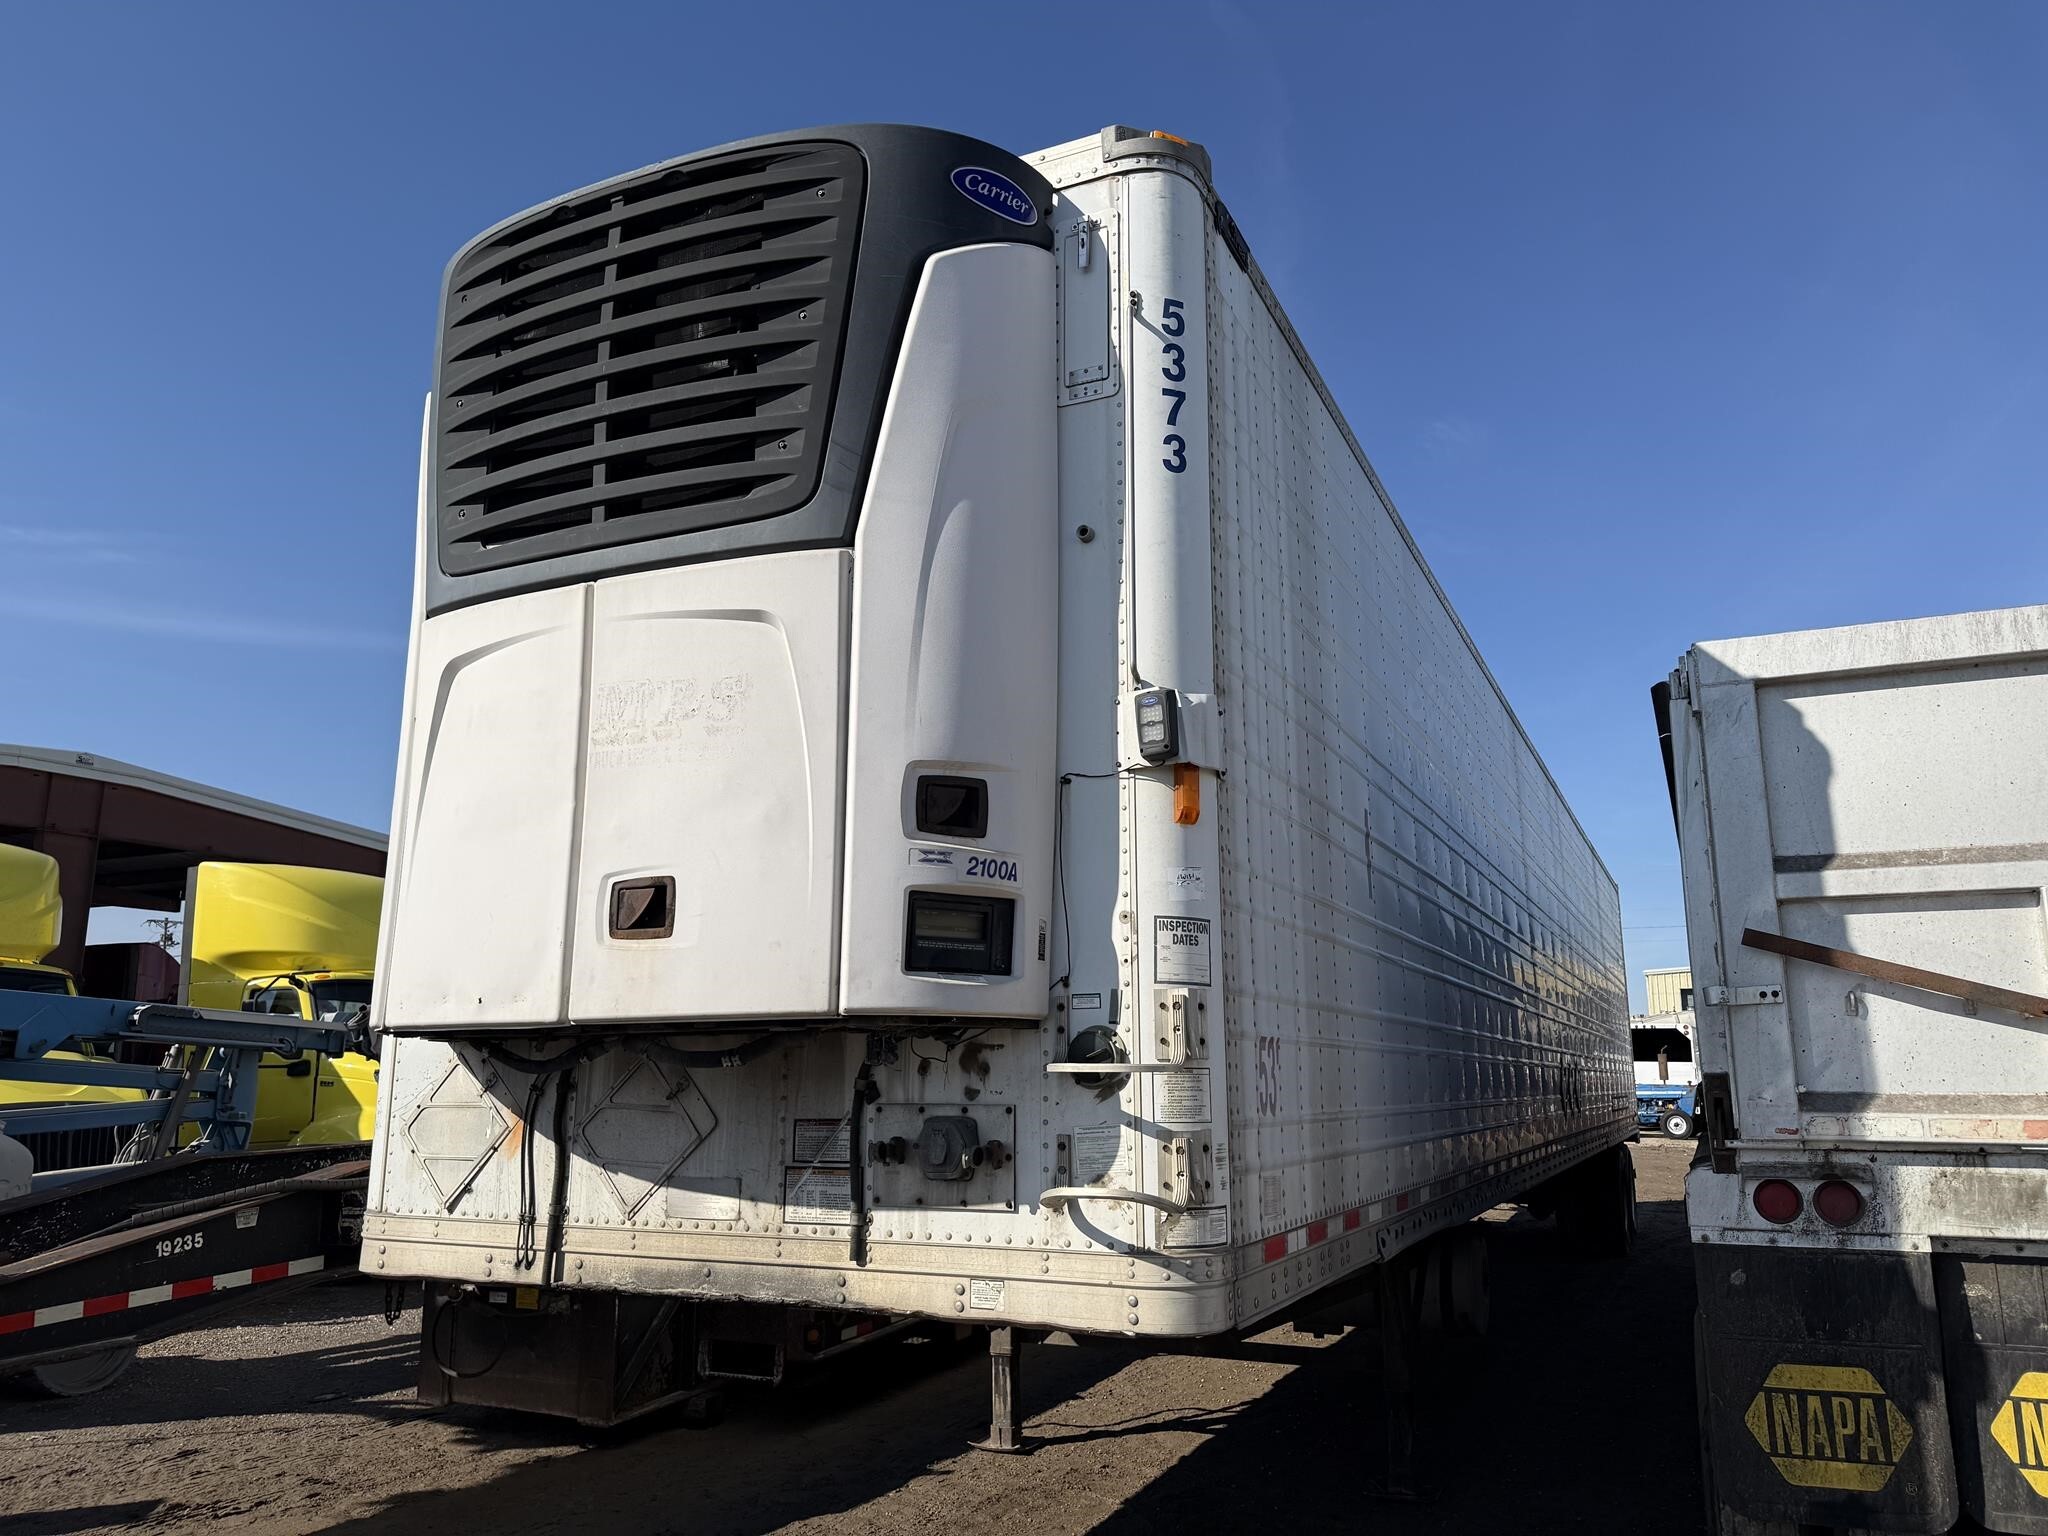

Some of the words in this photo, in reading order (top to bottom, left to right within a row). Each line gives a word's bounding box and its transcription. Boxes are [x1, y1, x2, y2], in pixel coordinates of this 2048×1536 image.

[964, 173, 1029, 213] Carrier
[1161, 298, 1187, 474] 5373
[966, 856, 1018, 882] 2100A
[1158, 919, 1209, 936] INSPECTION
[1172, 934, 1199, 947] DATES
[155, 1231, 204, 1258] 19235
[1771, 1392, 1885, 1463] NAPA
